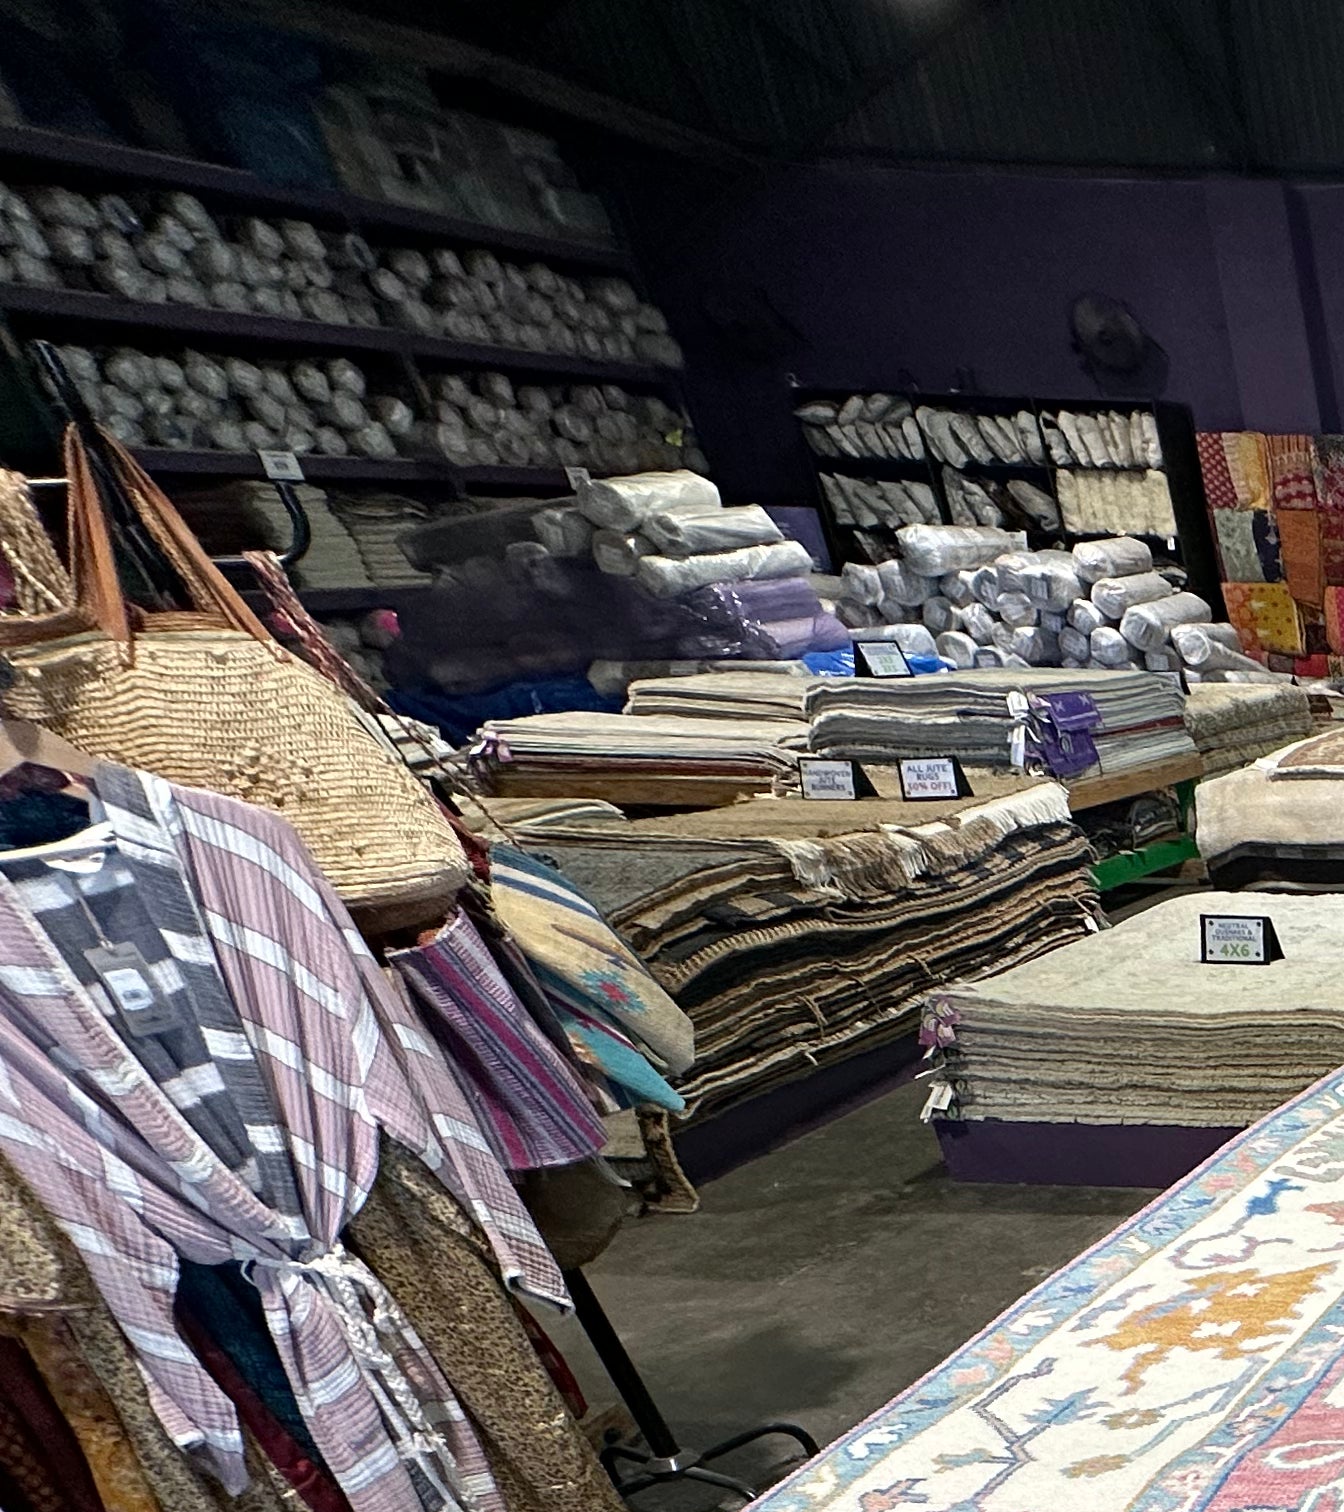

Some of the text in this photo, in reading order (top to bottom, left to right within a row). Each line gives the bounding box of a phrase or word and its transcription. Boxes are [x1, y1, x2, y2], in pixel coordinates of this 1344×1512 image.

[907, 764, 948, 773] ALL JUTE
[916, 773, 939, 781] RUGS
[1218, 922, 1249, 930] NEUTRAL
[1211, 934, 1258, 942] TRADITIONAL
[1220, 943, 1250, 957] 4X6
